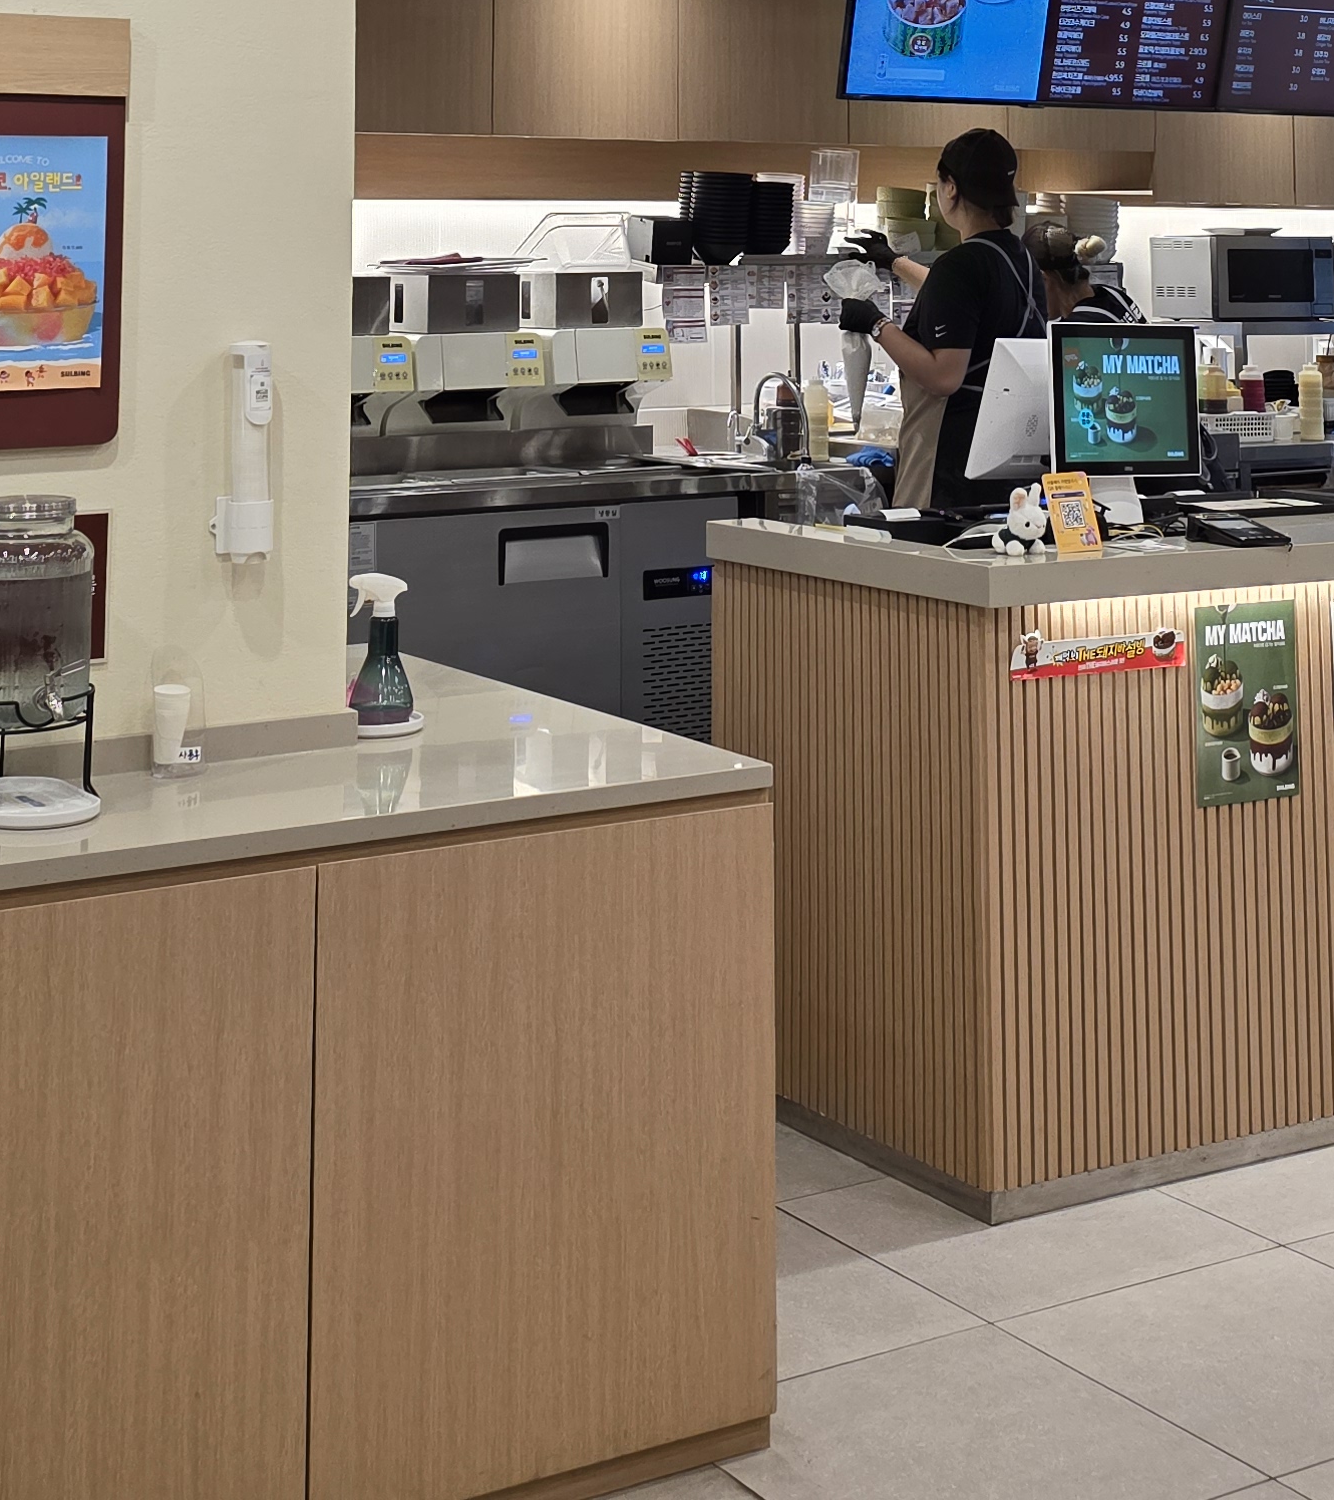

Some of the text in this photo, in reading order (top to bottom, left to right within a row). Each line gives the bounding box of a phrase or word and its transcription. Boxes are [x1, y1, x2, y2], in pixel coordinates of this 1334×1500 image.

[36, 156, 50, 166] TO
[1102, 354, 1181, 375] MY MATCHA
[60, 370, 91, 378] SULBING
[1205, 619, 1286, 646] MY MATCHA
